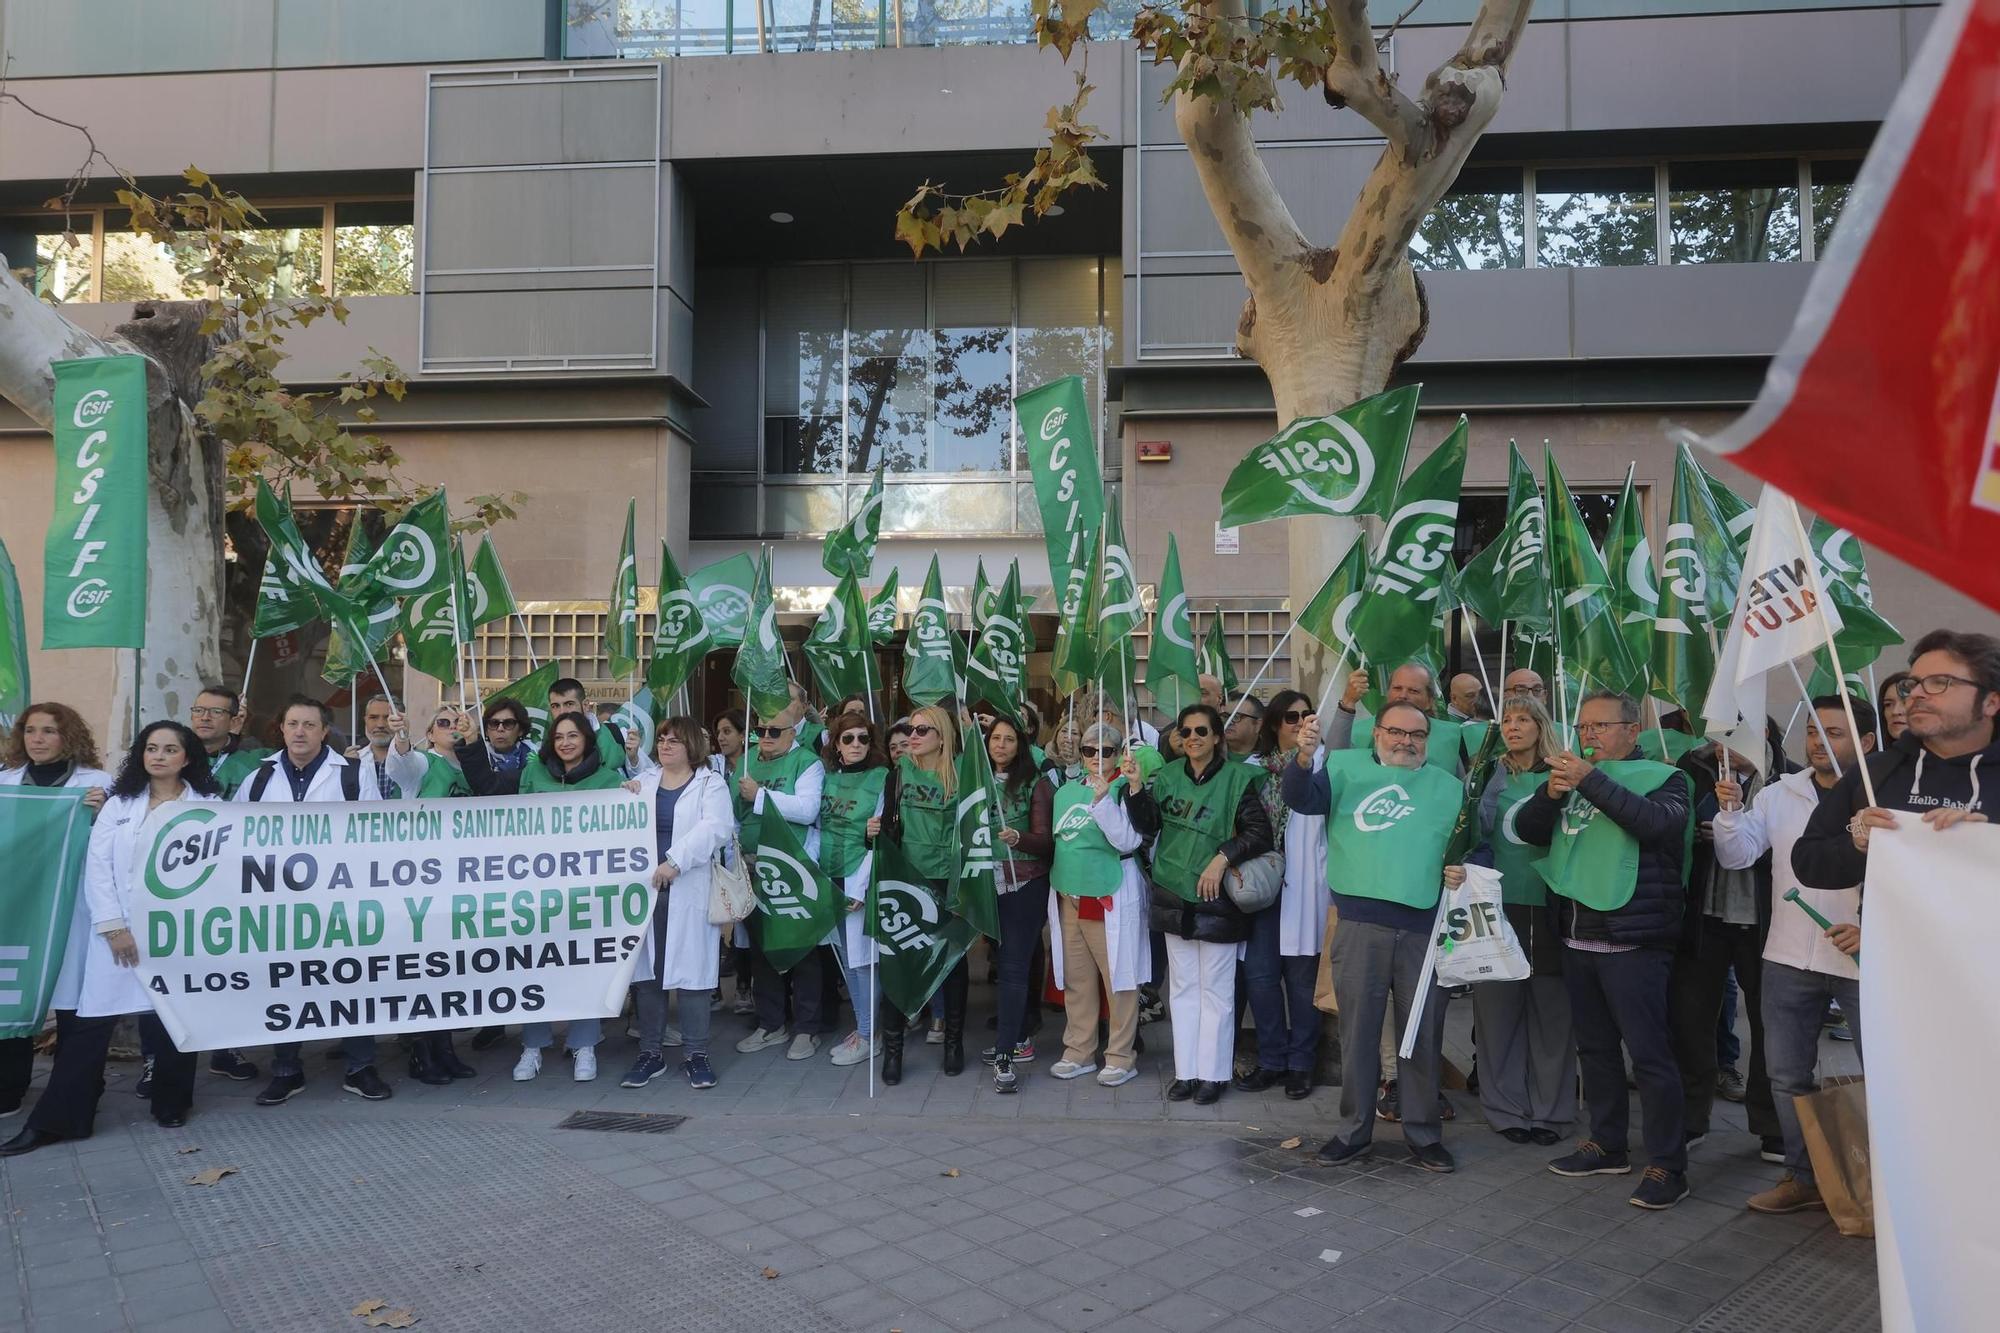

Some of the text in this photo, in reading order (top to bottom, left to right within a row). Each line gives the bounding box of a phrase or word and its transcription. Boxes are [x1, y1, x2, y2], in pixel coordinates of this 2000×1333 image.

[82, 400, 114, 416] CSIF
[1046, 412, 1069, 431] CSIF
[75, 590, 112, 605] CSIF
[583, 686, 627, 698] SANITAT
[1367, 798, 1416, 820] CSIF
[1907, 795, 1939, 806] Hello
[243, 801, 649, 848] POR UNA ATENCIÓN SANITARIA DE CALIDAD
[161, 823, 233, 873] CSIF
[241, 846, 650, 894] NO A LOS RECORTES
[755, 861, 813, 920] CSIF
[148, 882, 650, 958] DIGNIDAD Y RESPETO
[879, 897, 935, 951] CSIF
[1437, 901, 1497, 947] SIF
[149, 975, 170, 995] A
[184, 971, 250, 993] LOS
[264, 984, 546, 1032] SANITARIOS
